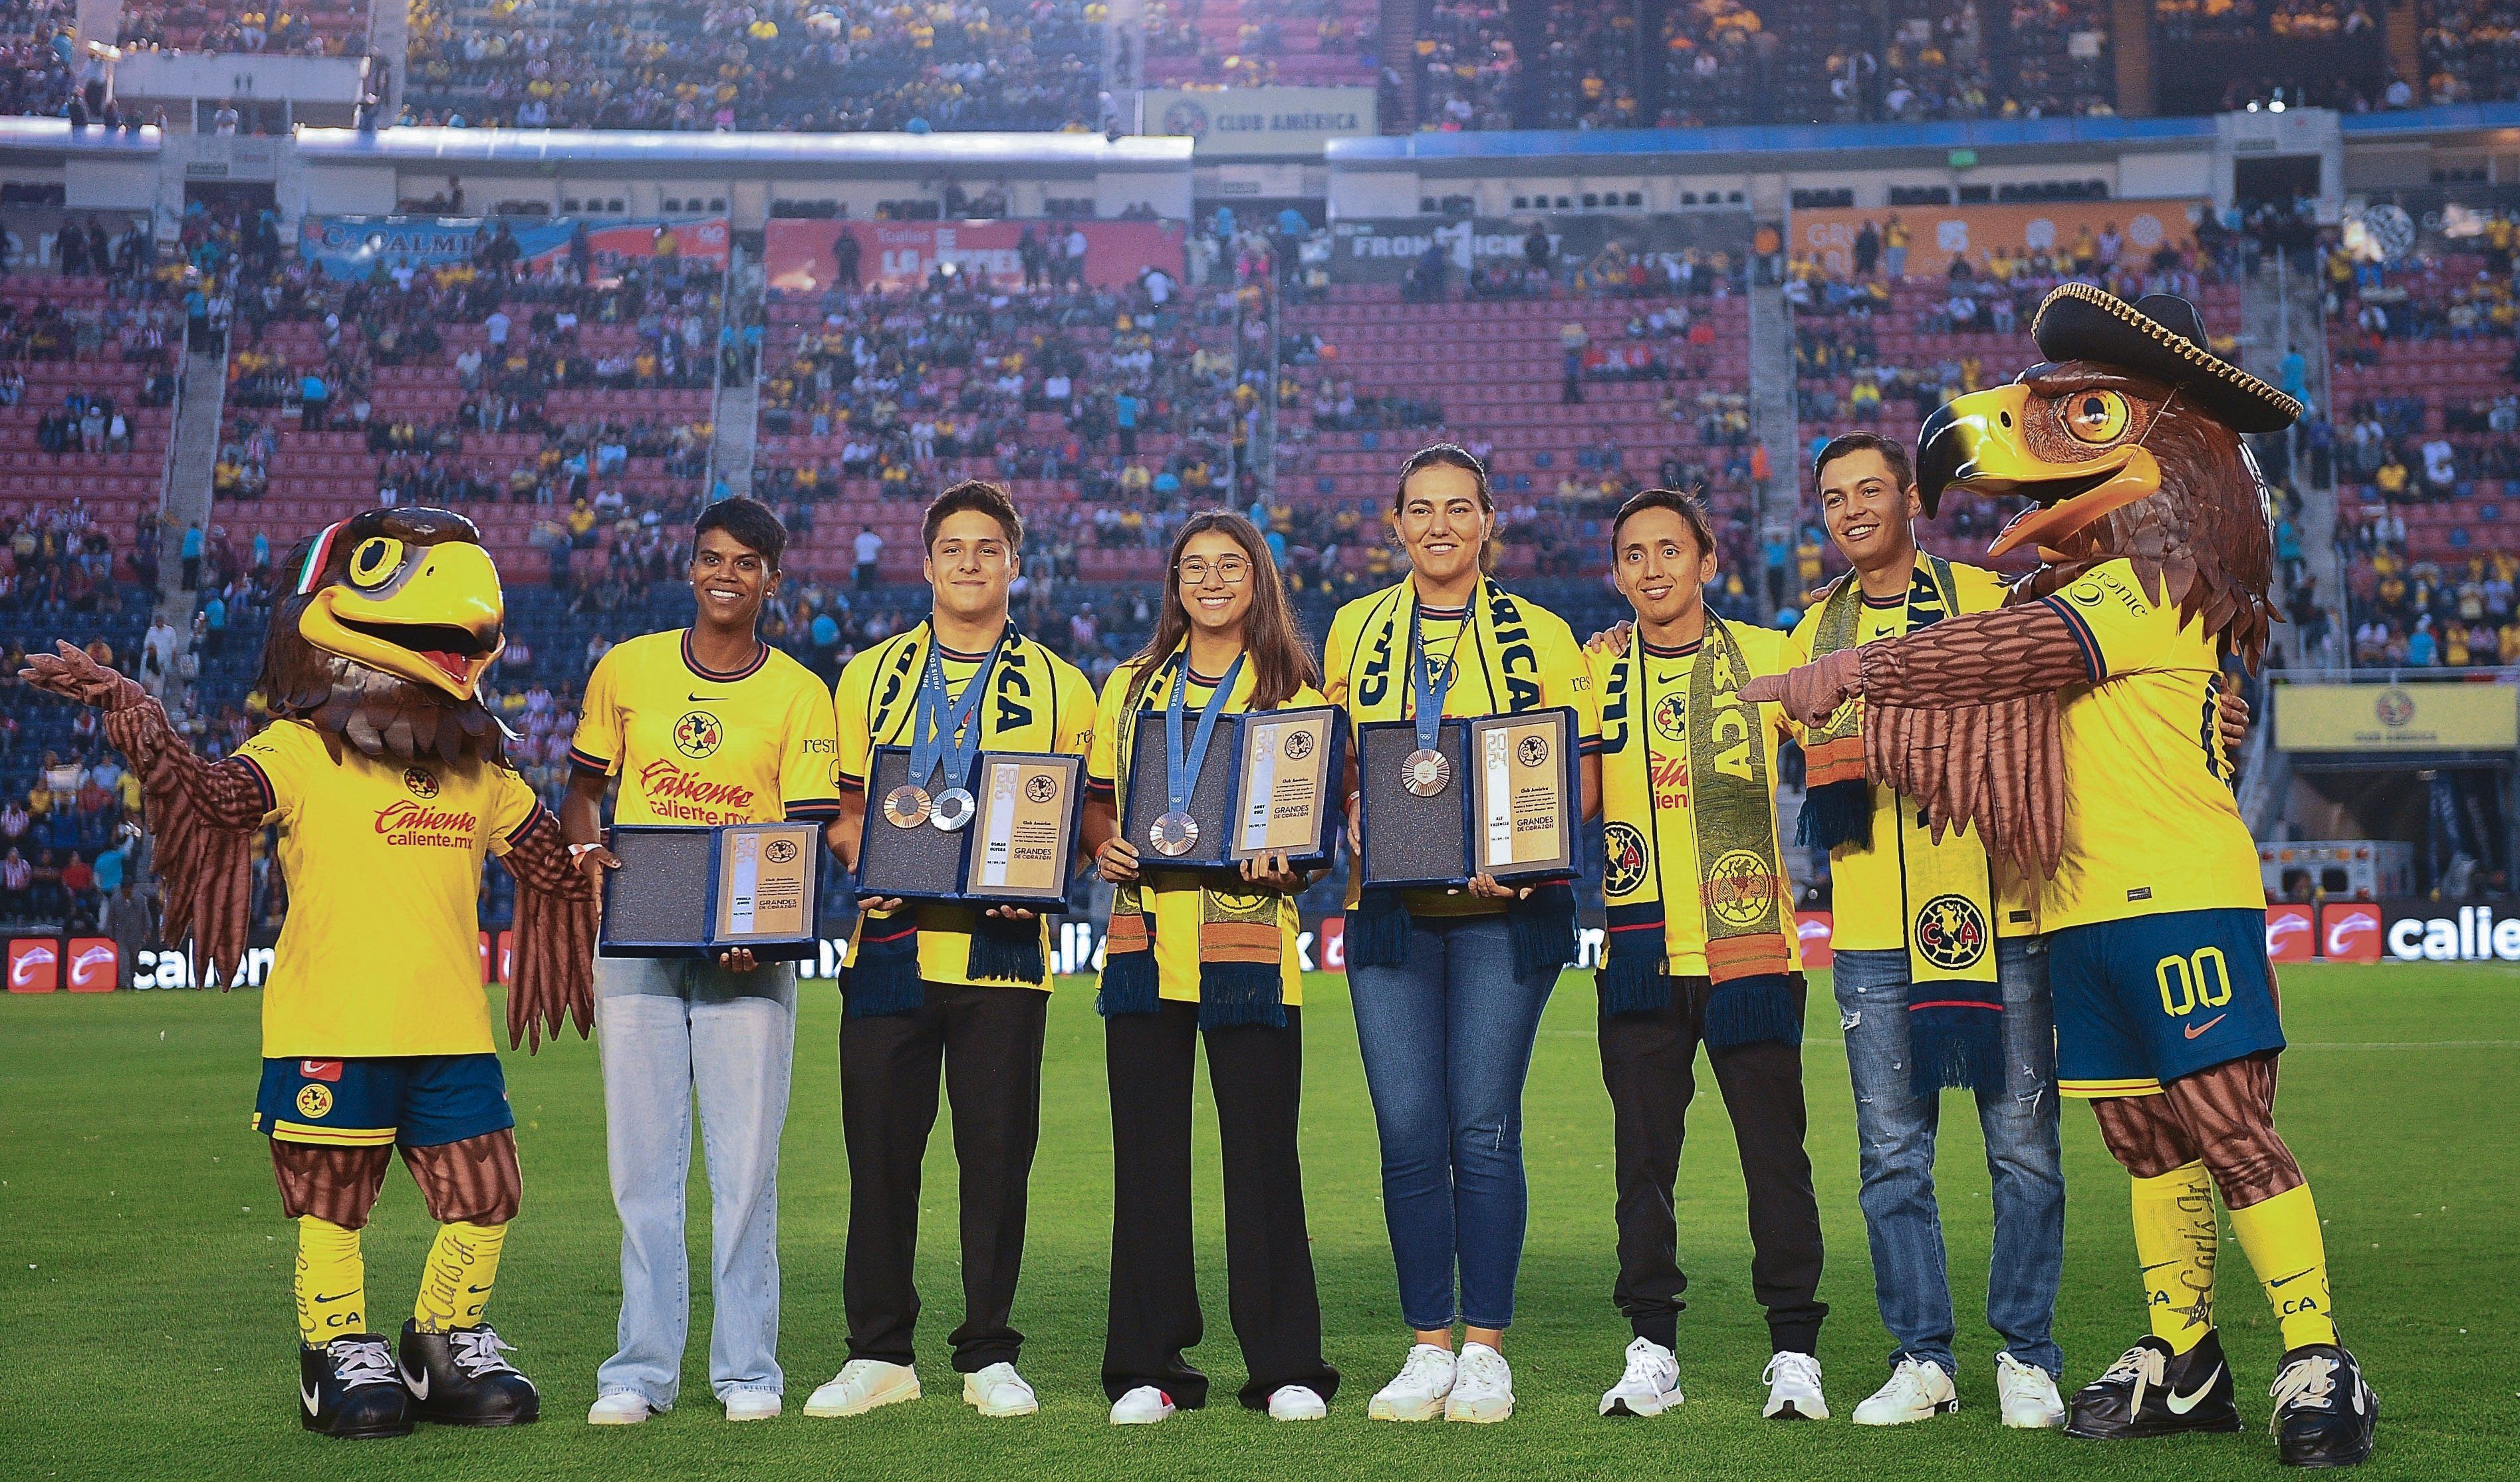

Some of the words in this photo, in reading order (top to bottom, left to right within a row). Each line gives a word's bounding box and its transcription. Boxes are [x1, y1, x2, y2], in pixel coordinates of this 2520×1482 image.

[640, 758, 754, 808] Caliente
[374, 799, 477, 834] Caliente
[1274, 804, 1309, 814] GRANDES
[1517, 816, 1554, 826] GRANDES
[387, 831, 474, 849] caliente.mx
[2156, 946, 2232, 1017] 00
[2283, 1297, 2317, 1314] CA
[326, 1311, 361, 1327] CA
